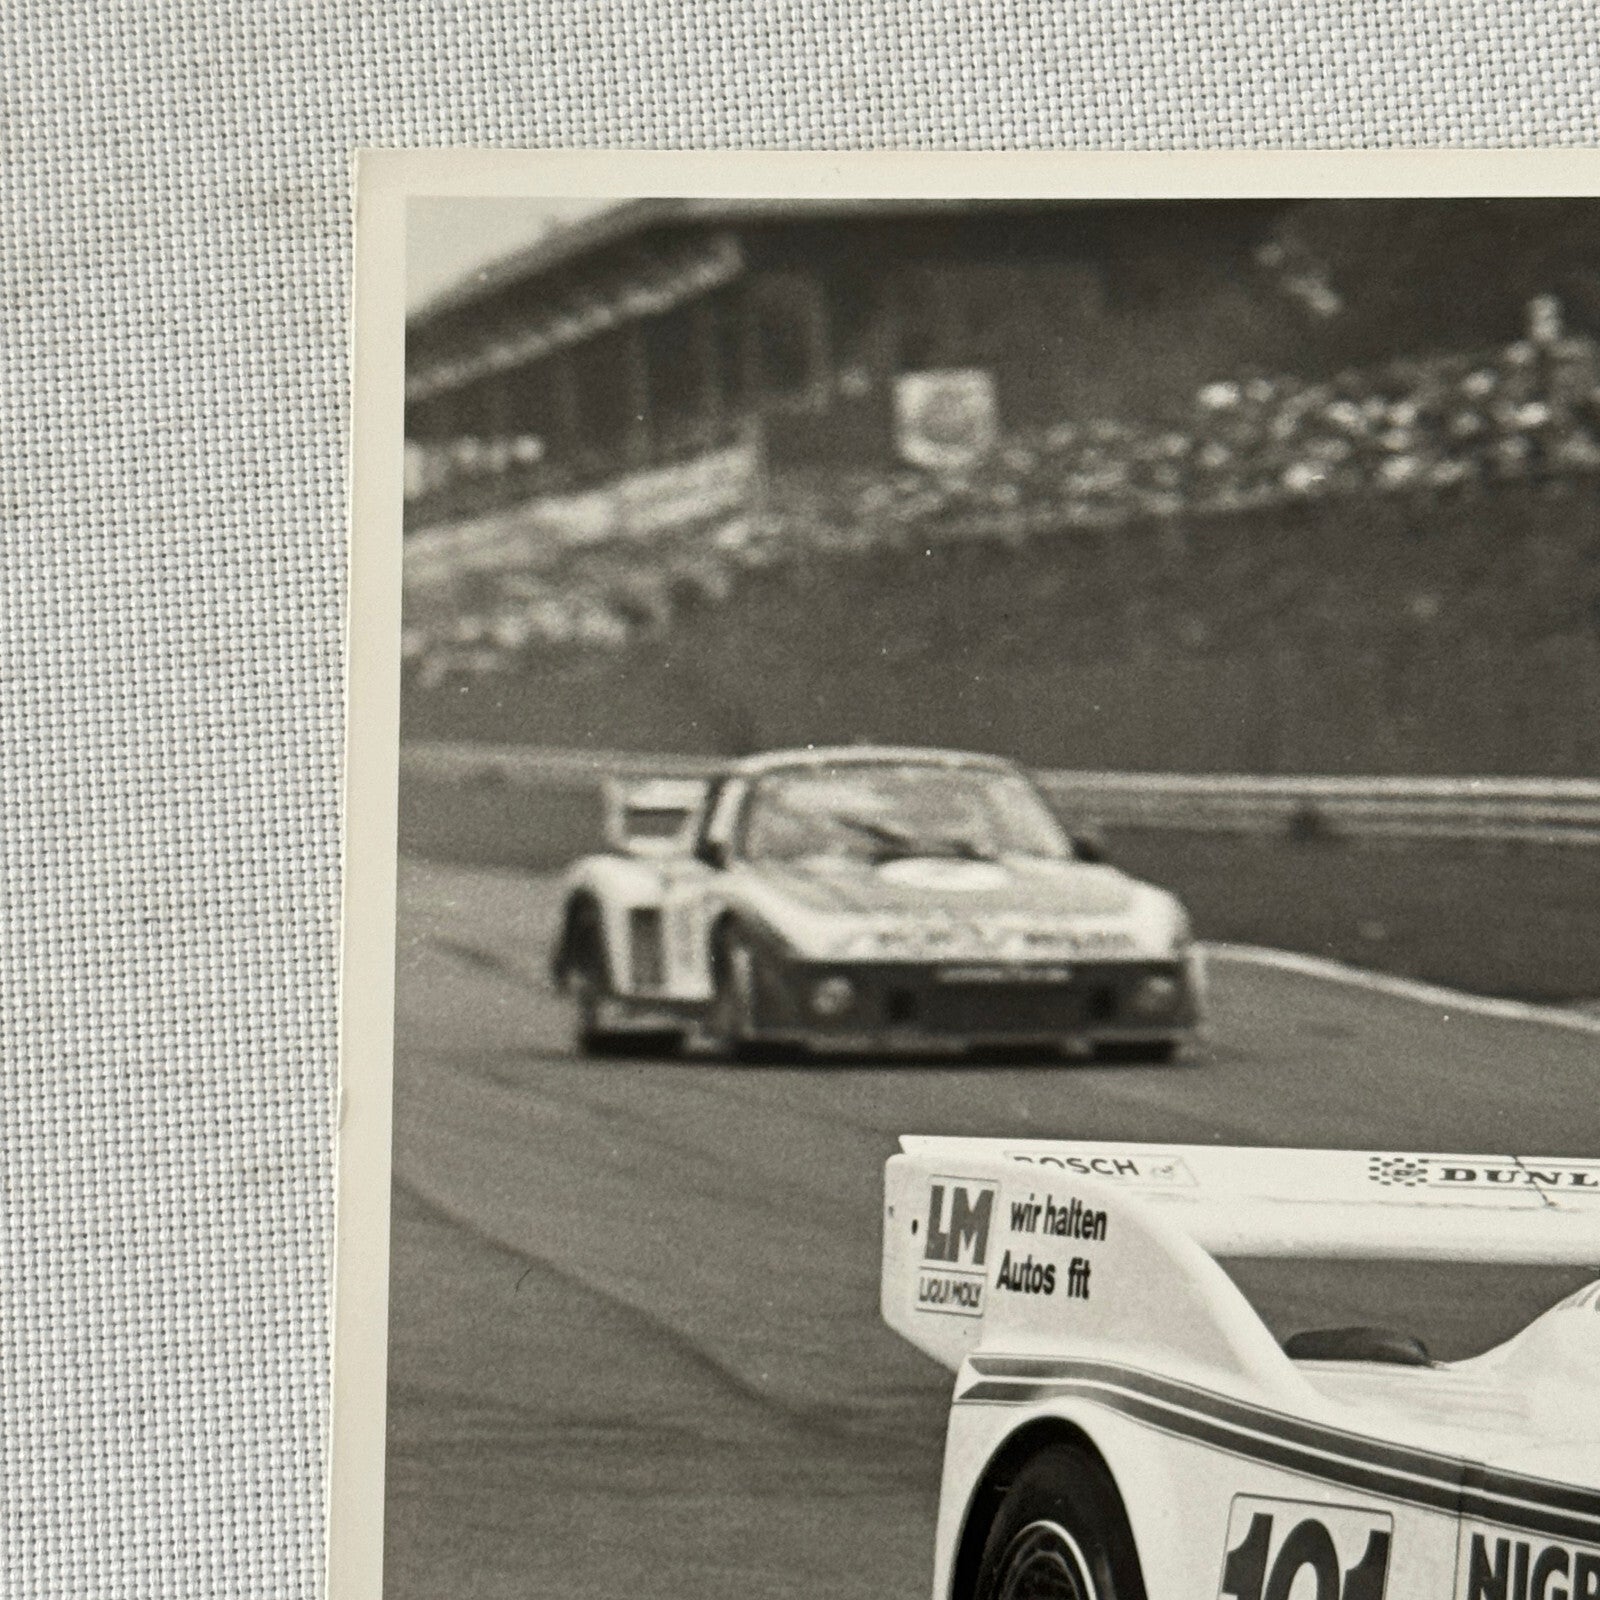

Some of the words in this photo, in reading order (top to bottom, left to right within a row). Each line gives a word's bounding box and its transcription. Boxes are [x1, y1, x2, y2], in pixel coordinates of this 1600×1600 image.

[924, 1184, 995, 1266] LM
[1010, 1193, 1042, 1233] wir
[1043, 1194, 1107, 1241] halten
[996, 1249, 1056, 1295] Autos
[1067, 1257, 1091, 1300] fit
